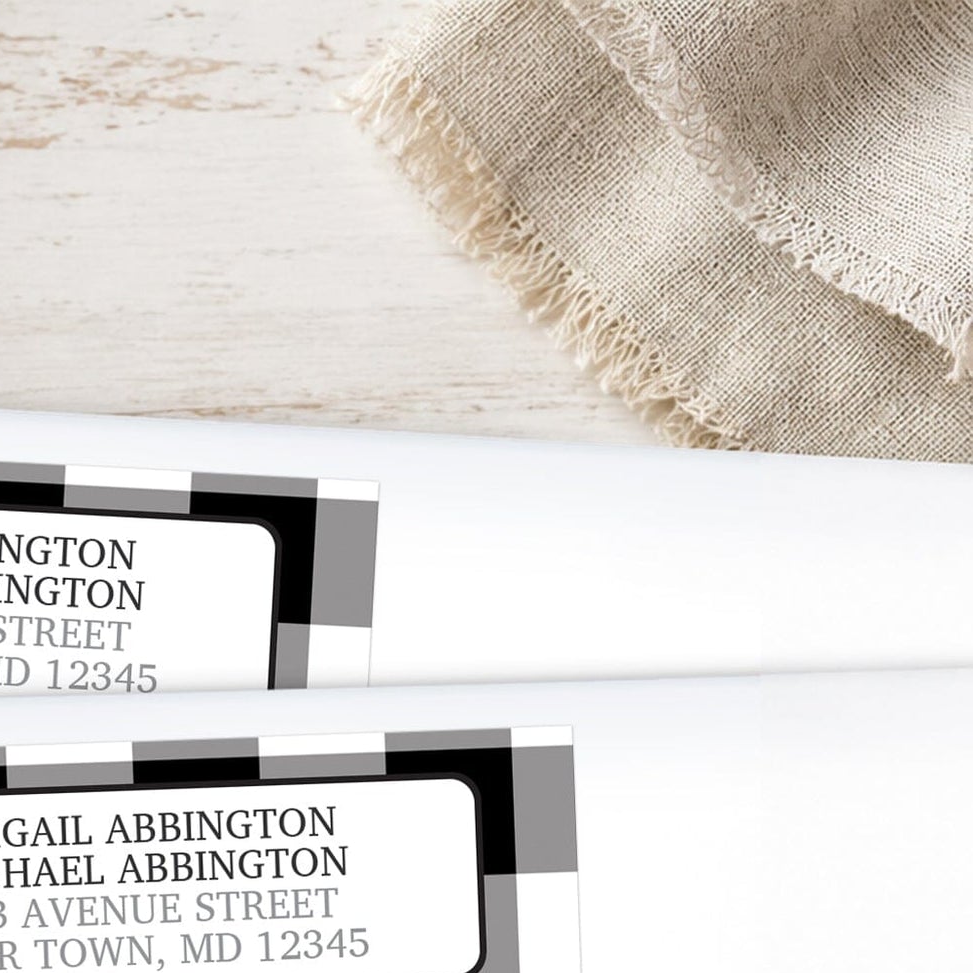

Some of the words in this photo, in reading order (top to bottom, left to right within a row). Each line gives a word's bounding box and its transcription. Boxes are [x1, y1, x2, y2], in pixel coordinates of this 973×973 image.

[47, 659, 158, 693] 12345
[105, 806, 336, 844] ABBINGTON
[117, 846, 348, 884] ABBINGTON
[21, 894, 182, 928] AVENUE
[195, 888, 339, 922] STREET
[34, 935, 165, 971] TOWN,
[180, 932, 242, 964] MD
[258, 927, 370, 962] 12345
